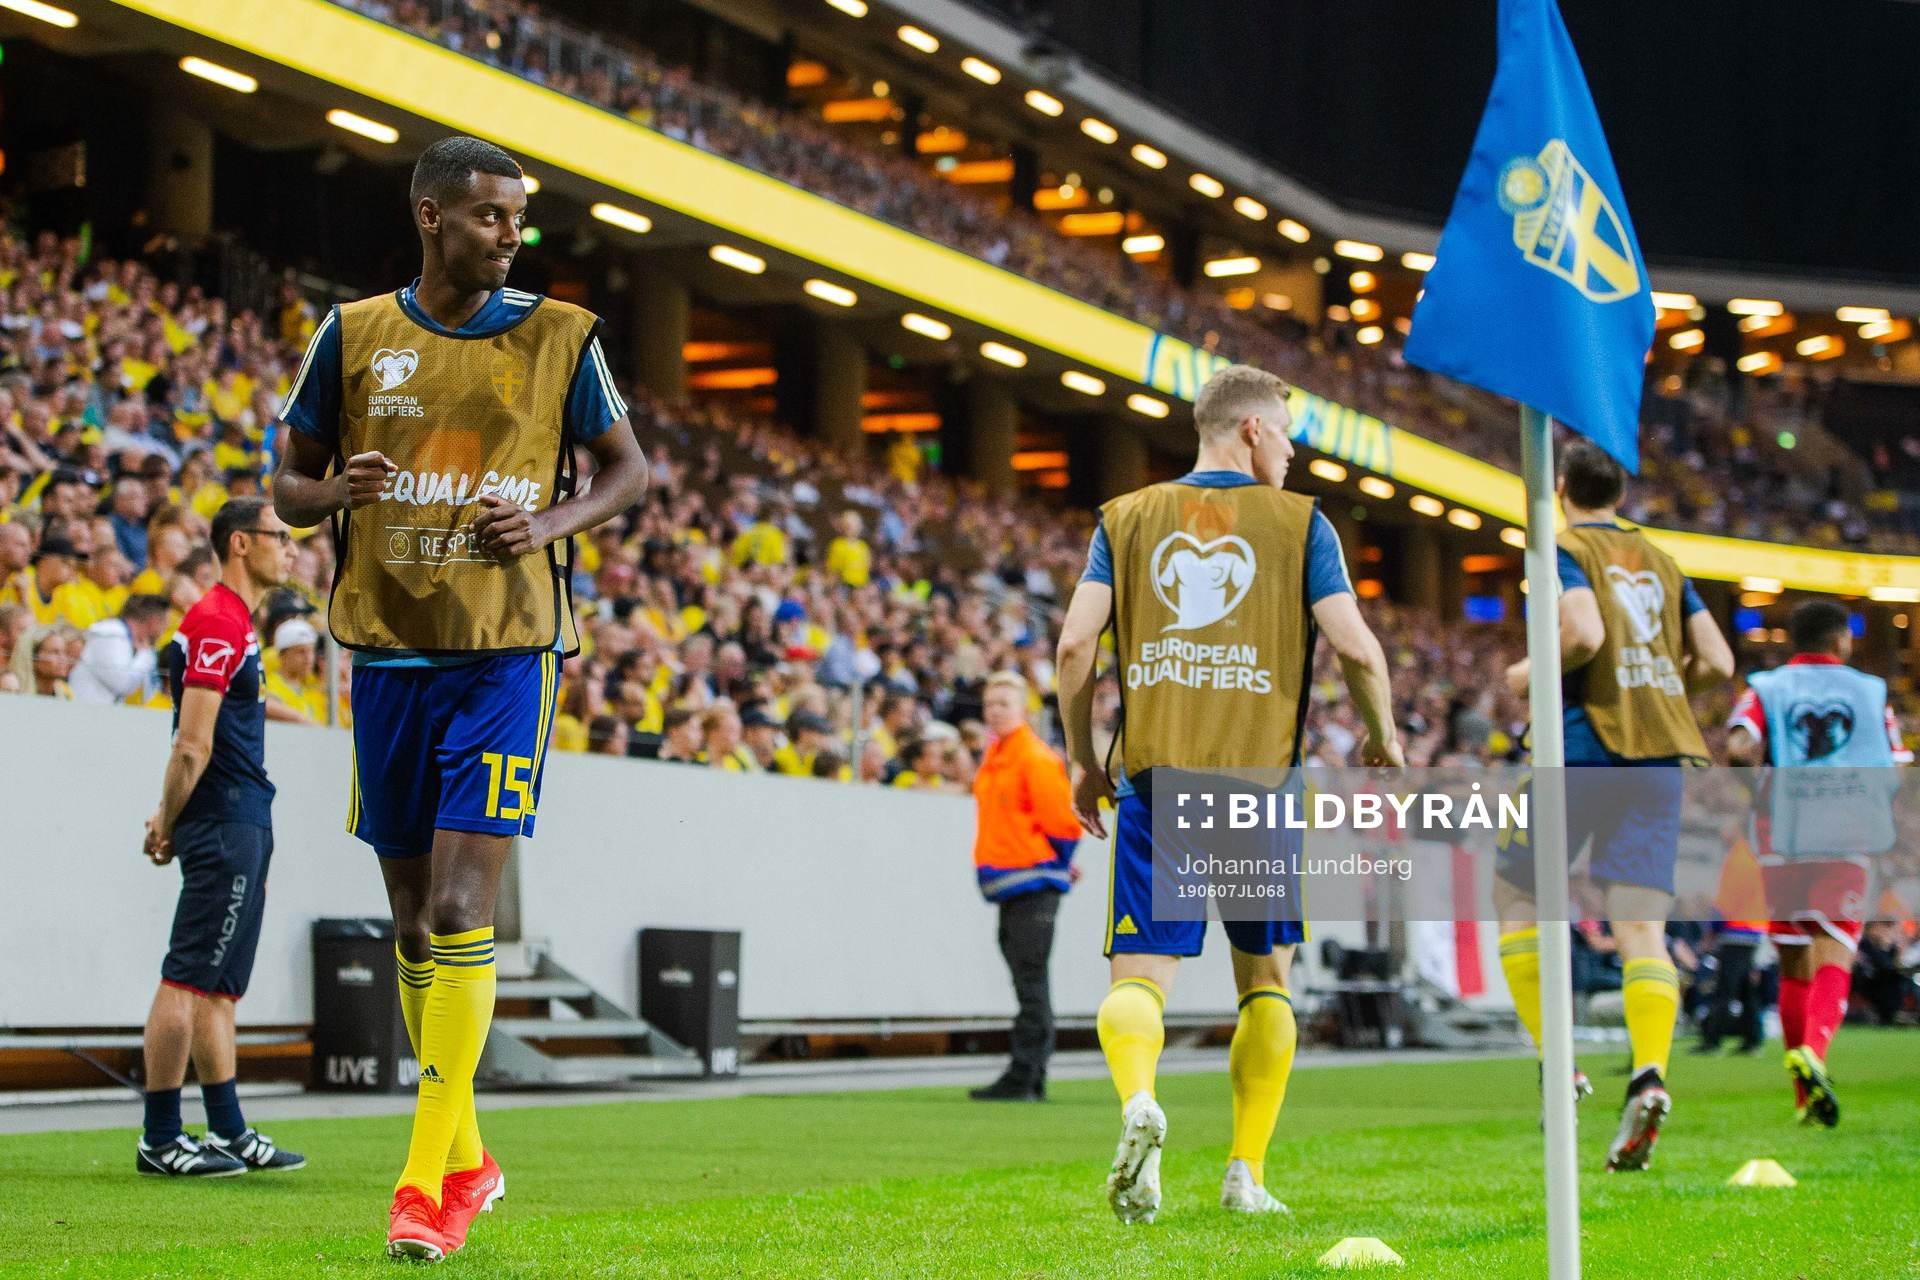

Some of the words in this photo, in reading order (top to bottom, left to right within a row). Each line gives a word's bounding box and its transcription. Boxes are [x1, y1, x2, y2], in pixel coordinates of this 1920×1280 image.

[367, 405, 425, 418] UALIFIERS
[1141, 637, 1258, 667] EUROPEAN
[1126, 658, 1273, 695] QUALIFIERS
[482, 752, 532, 820] 15
[325, 1055, 379, 1086] LIVE
